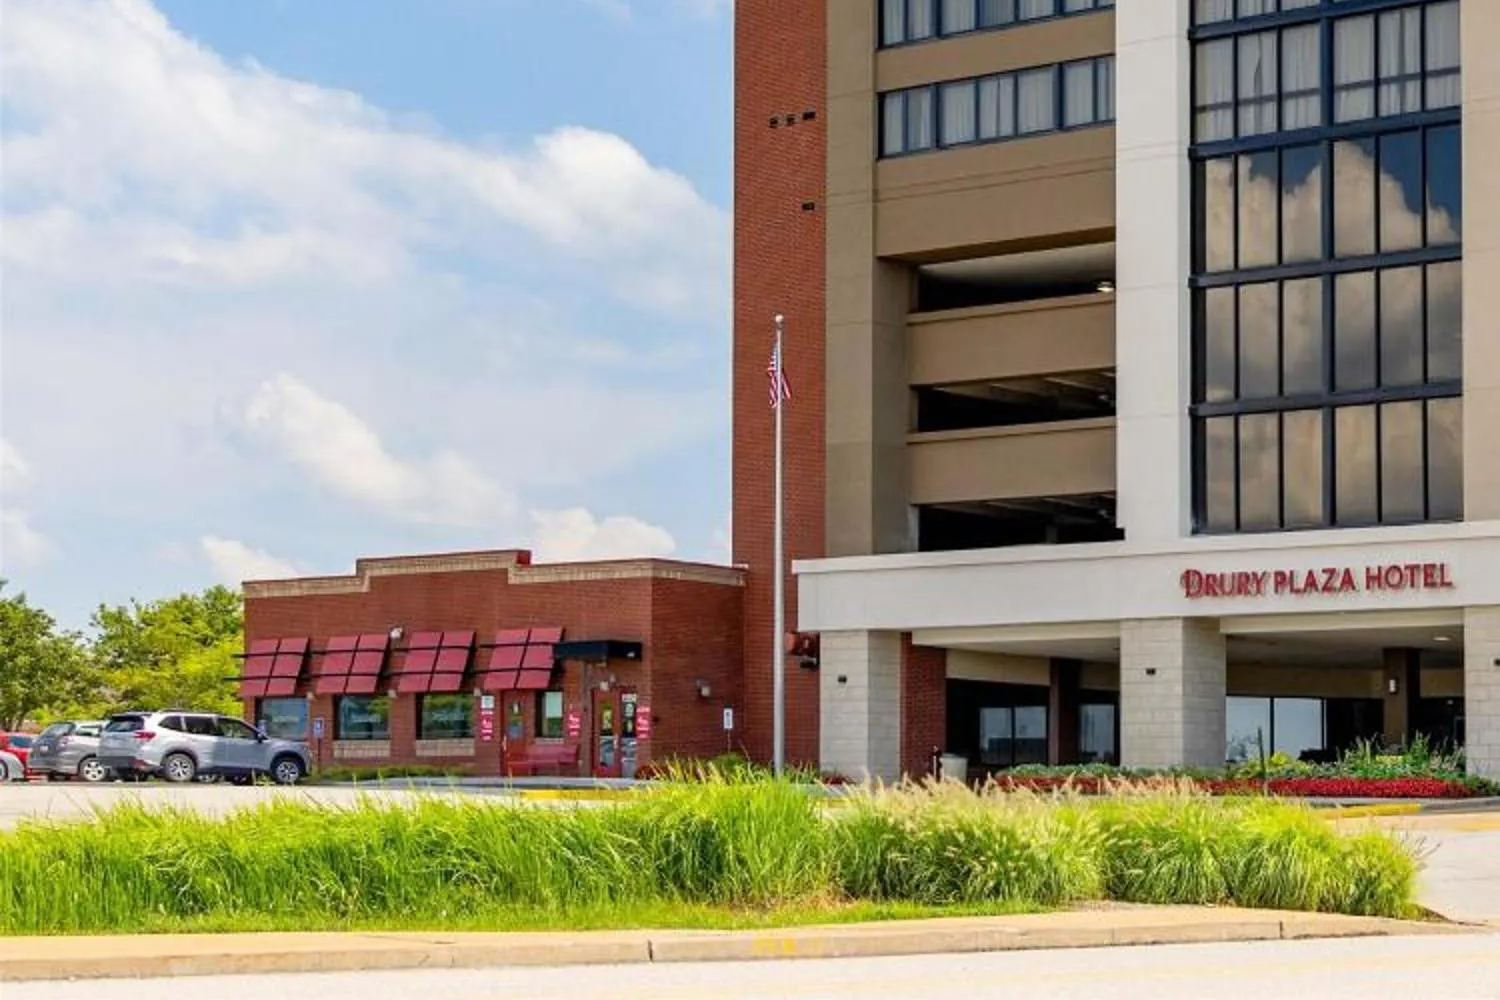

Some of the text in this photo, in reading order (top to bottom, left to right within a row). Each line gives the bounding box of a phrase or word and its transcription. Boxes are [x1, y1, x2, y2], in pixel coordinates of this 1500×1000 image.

[1180, 563, 1453, 598] DRURY PLAZA HOTEL
